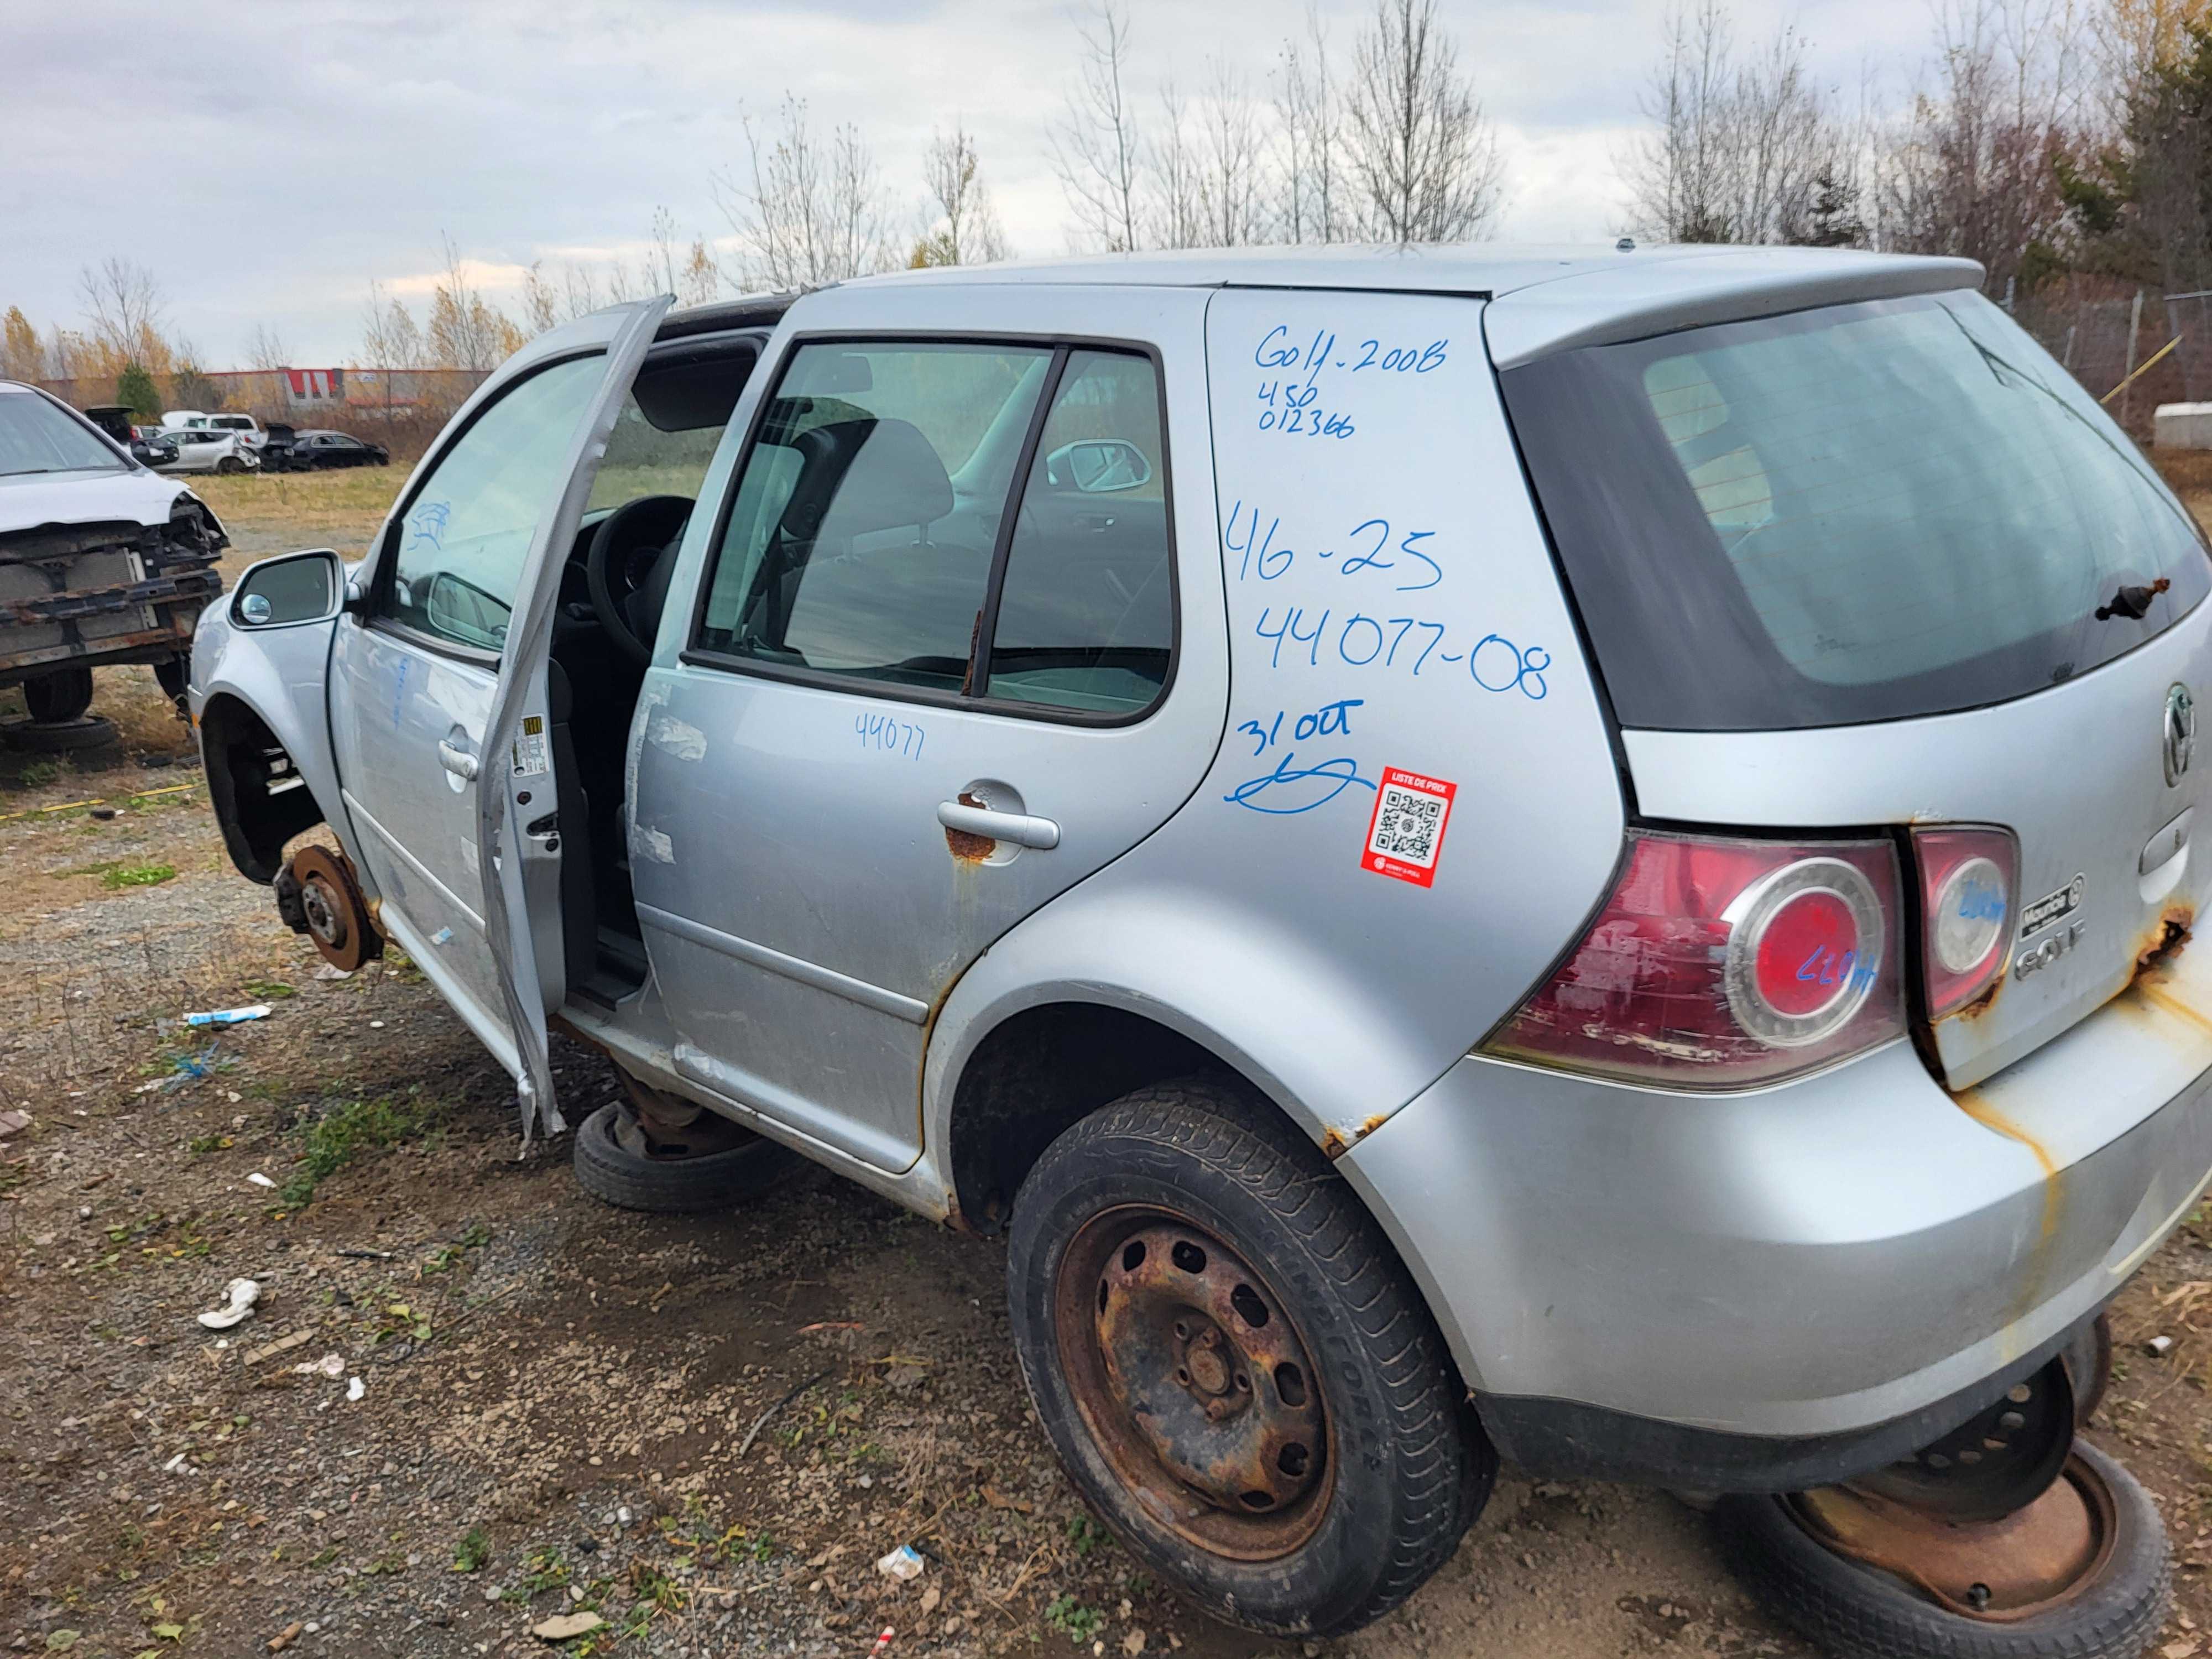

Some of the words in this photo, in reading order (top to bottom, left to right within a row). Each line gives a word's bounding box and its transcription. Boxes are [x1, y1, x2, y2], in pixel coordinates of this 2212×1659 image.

[1258, 382, 1318, 408] 450
[1259, 408, 1355, 439] 012366
[1256, 606, 1552, 701] 44077-08
[855, 713, 926, 761] 44077
[1237, 711, 1285, 757] 31
[1391, 771, 1413, 785] LISTE
[1413, 778, 1426, 789] DE
[1426, 780, 1448, 794] PRIX
